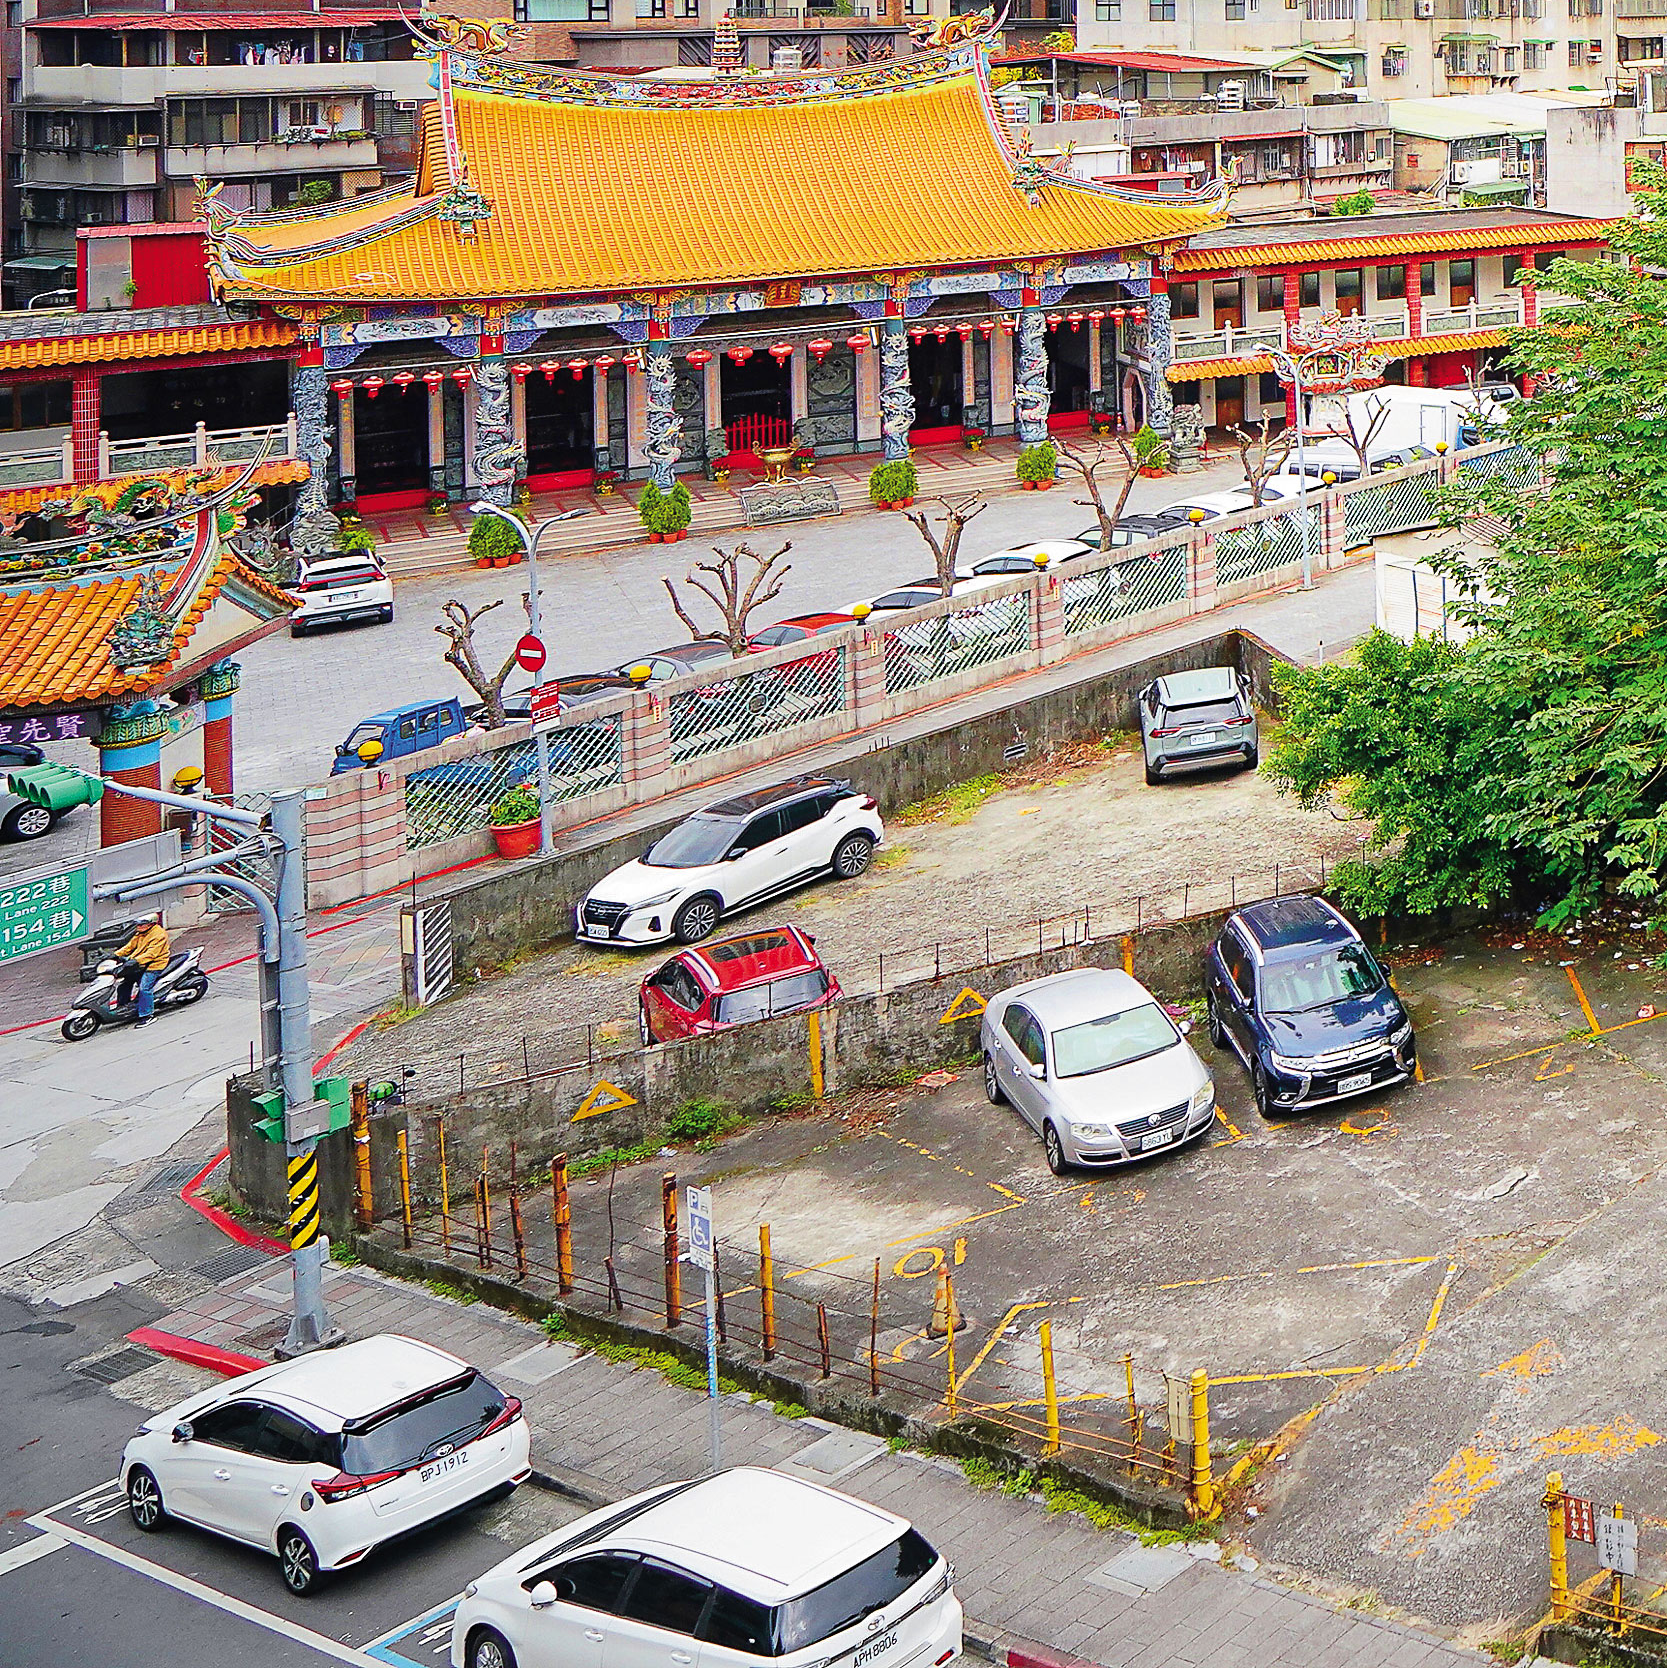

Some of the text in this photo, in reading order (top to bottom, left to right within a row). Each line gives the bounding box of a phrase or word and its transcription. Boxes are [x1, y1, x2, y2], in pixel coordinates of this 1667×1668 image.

[0, 875, 70, 908] 222巷
[5, 894, 70, 921] Lane 222
[2, 910, 71, 943] 154巷
[12, 939, 42, 954] Lane
[46, 929, 71, 944] 154
